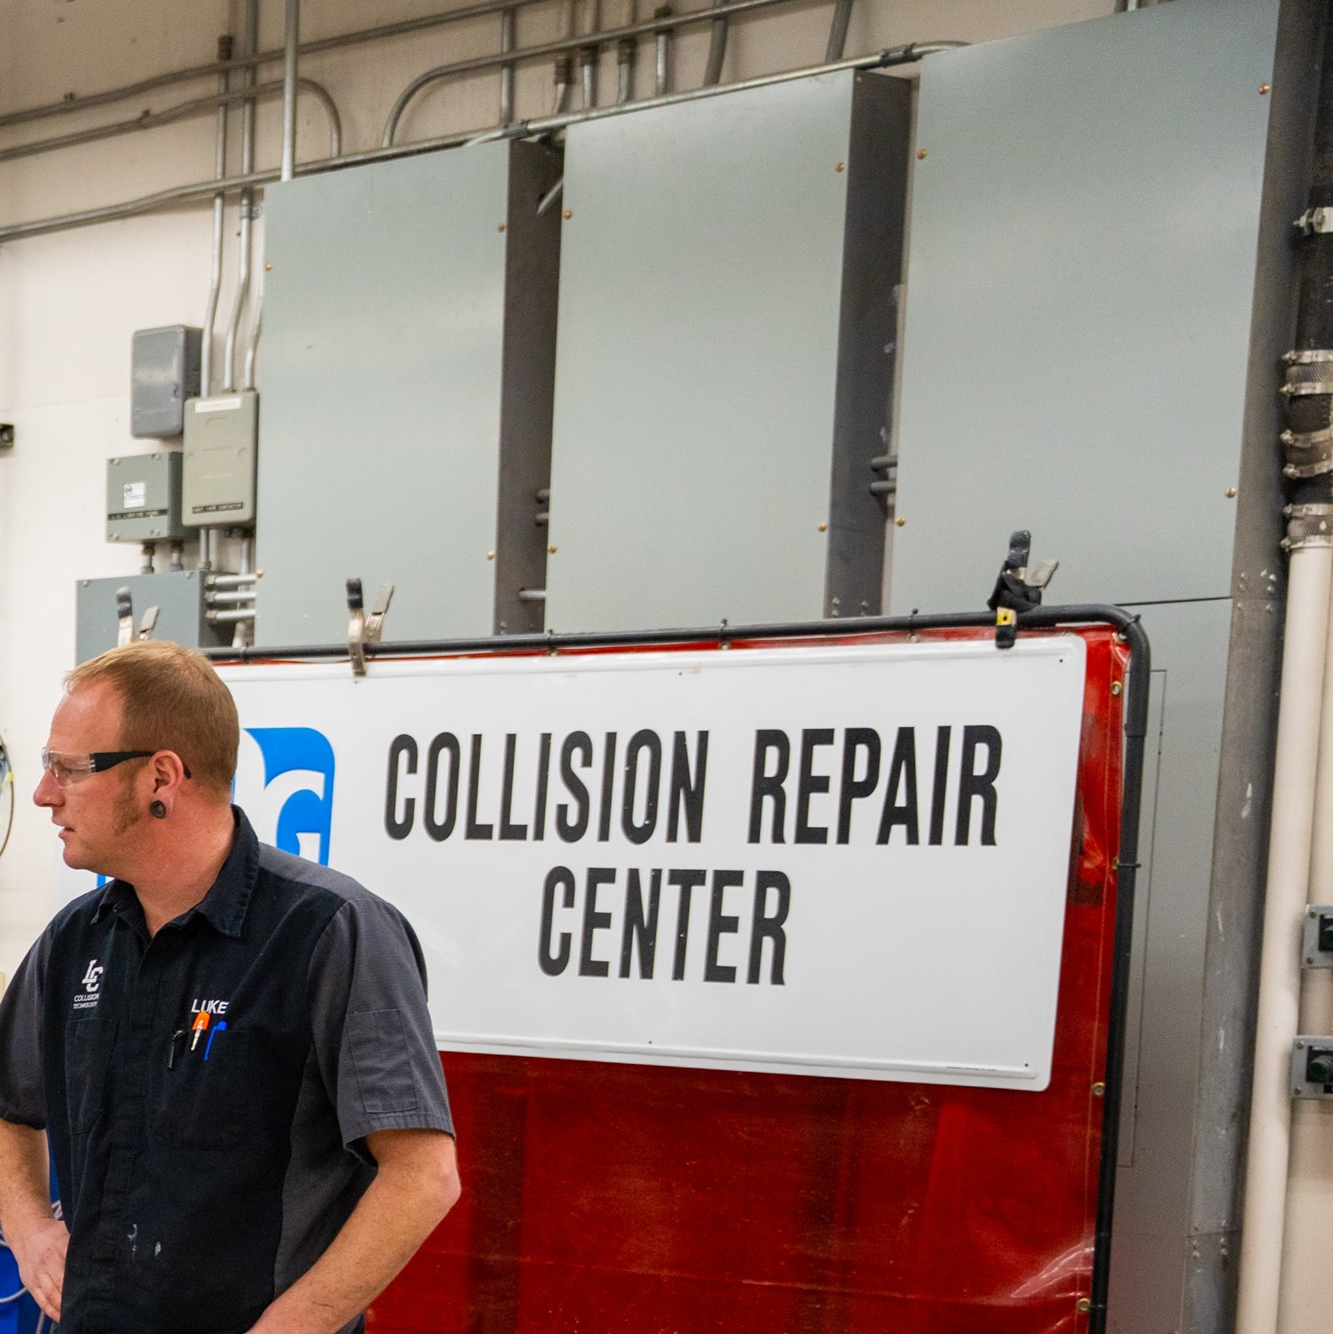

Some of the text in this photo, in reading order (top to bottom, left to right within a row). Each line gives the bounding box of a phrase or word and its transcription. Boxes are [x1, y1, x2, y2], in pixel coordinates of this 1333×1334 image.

[384, 728, 709, 845] COLLISION
[746, 724, 1003, 846] REPAIR
[537, 865, 792, 985] CENTER
[190, 999, 230, 1014] LUKE
